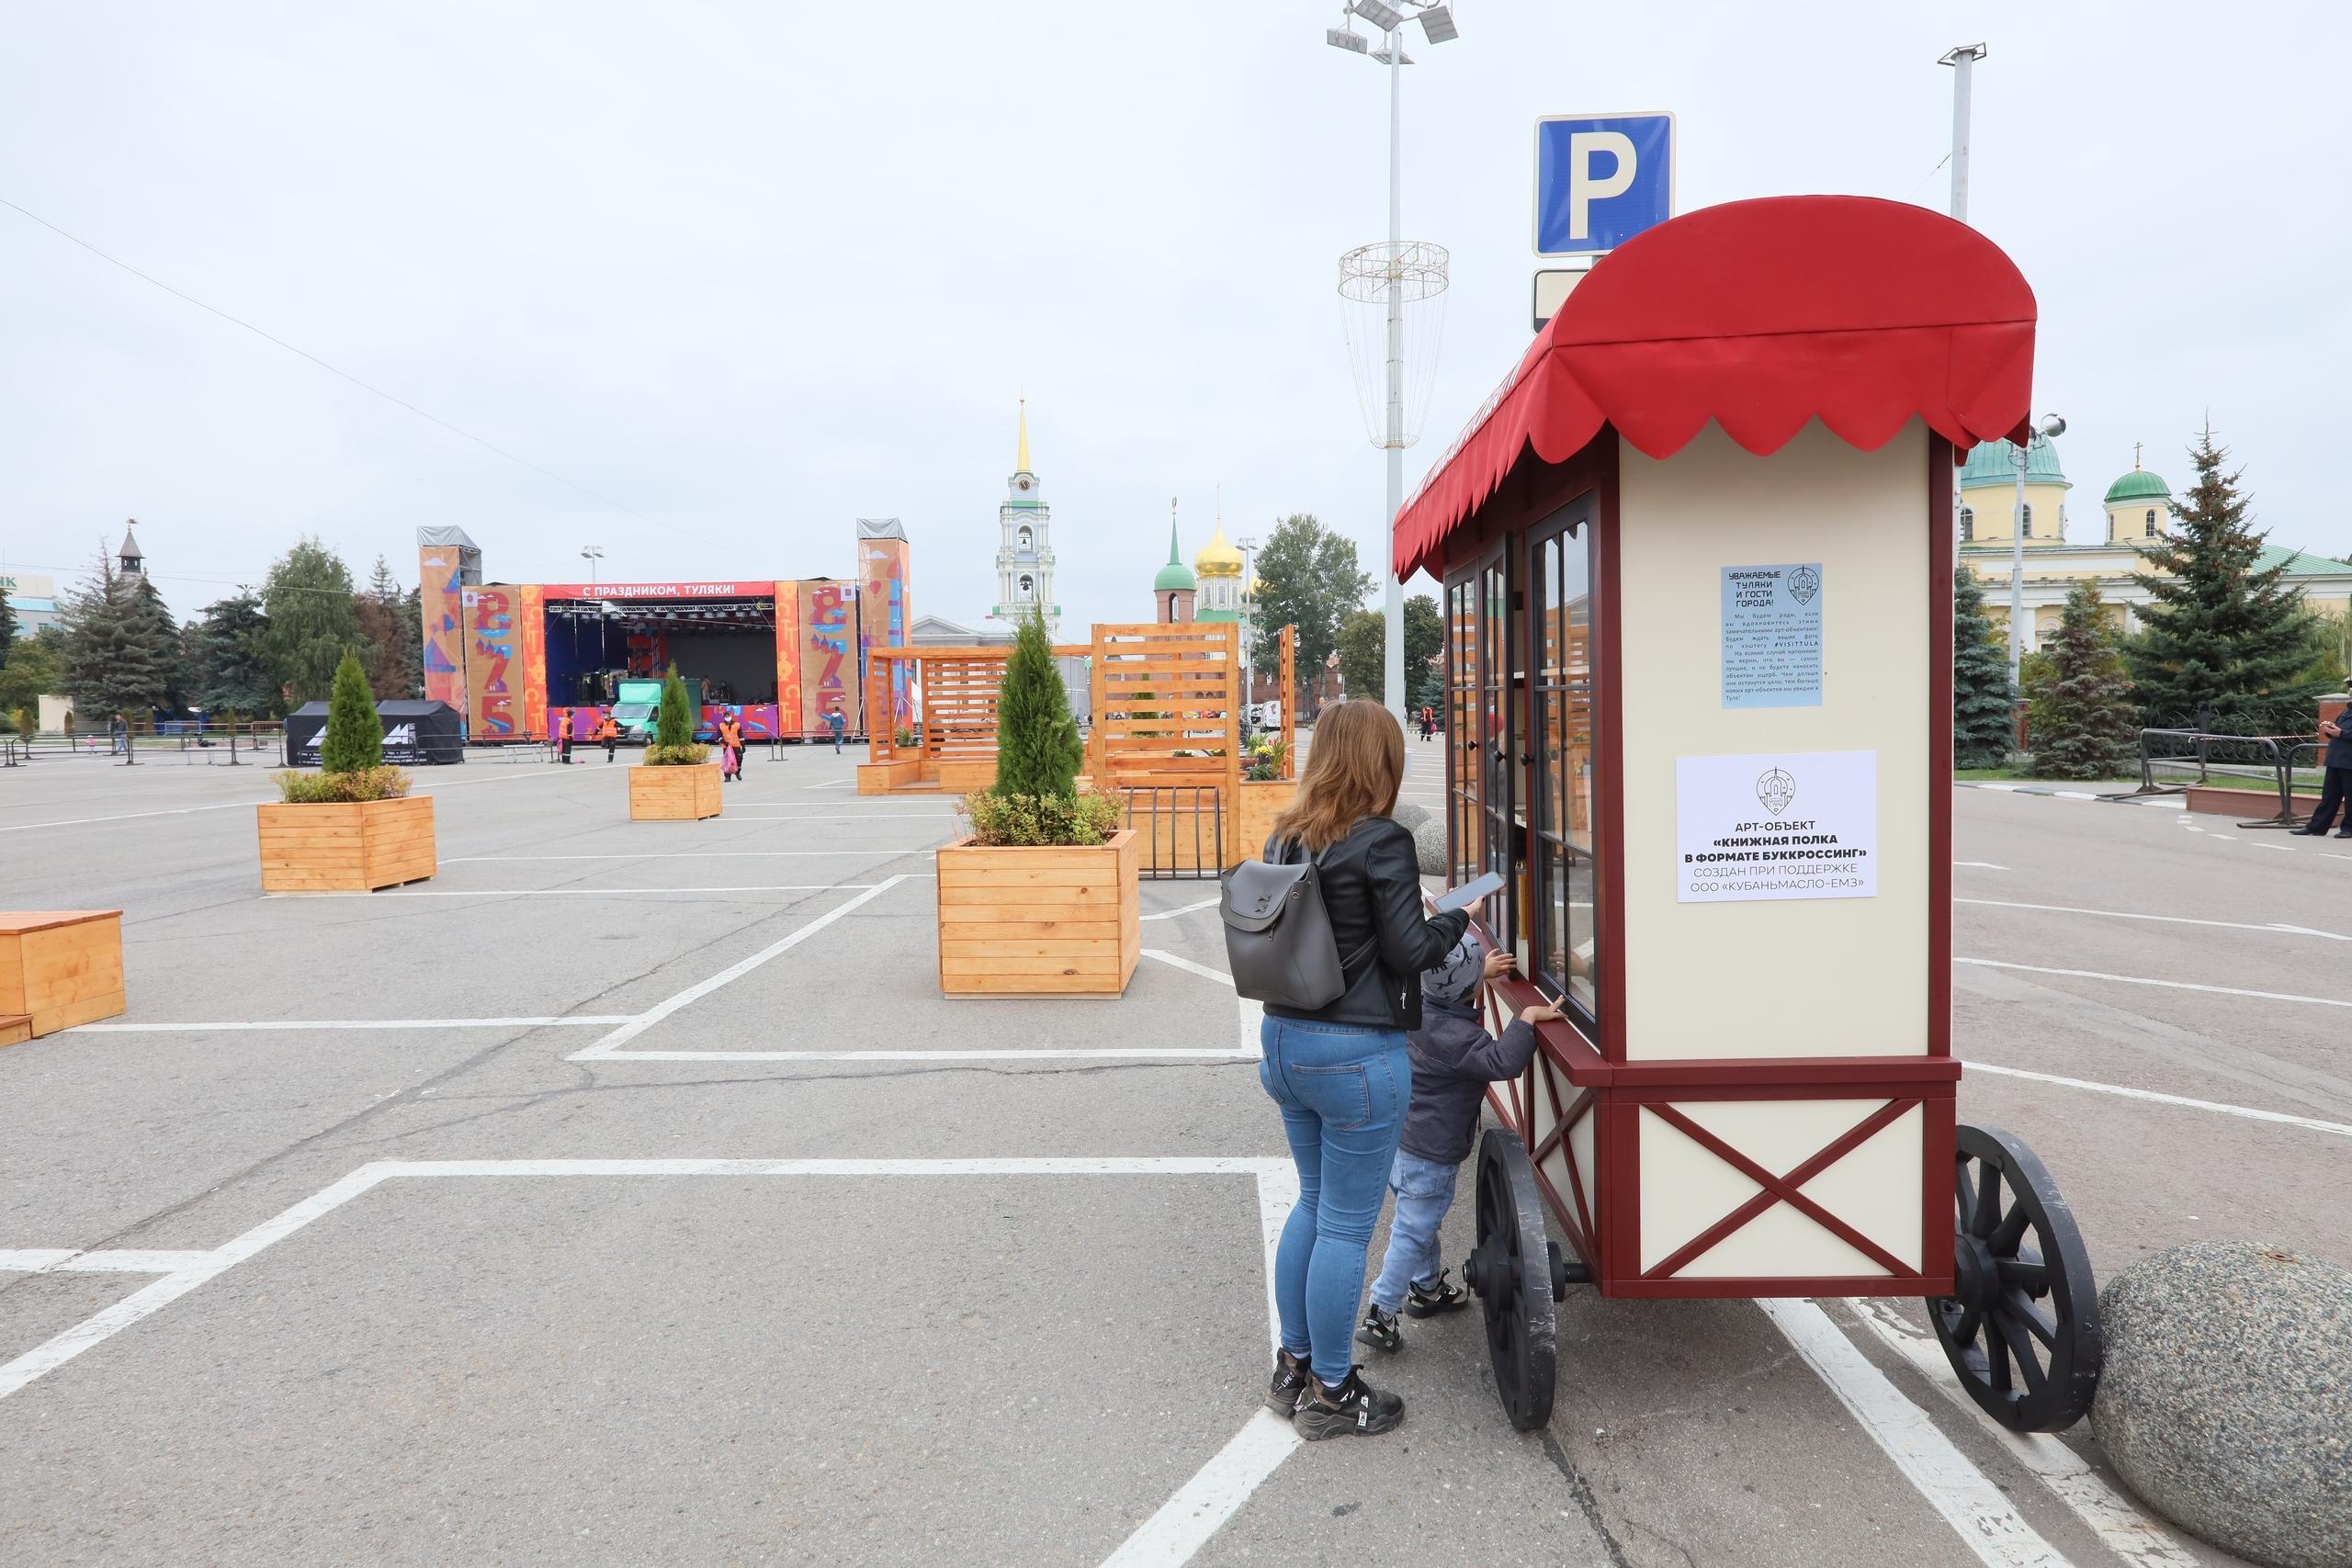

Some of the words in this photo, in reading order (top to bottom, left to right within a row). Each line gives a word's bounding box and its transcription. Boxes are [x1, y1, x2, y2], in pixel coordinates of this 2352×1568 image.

[1569, 131, 1637, 240] P
[1728, 571, 1781, 580] УВАЖАЕМЫЕ
[583, 587, 591, 597] С
[594, 585, 680, 597] ПРАЗДНИКОМ,
[684, 584, 735, 595] ТУЛЯКИ!
[1736, 599, 1773, 607] ГОРОДА!
[1735, 820, 1815, 832] АРТ-ОБЪЕКТ
[1713, 837, 1790, 848] «КНИЖНАЯ
[1792, 835, 1838, 845] ПОЛКА
[1684, 854, 1693, 863] В
[1695, 852, 1759, 863] ФОРМАТЕ
[1762, 849, 1867, 861] БУККРОССИНГ»
[1693, 867, 1747, 878] СОЗДАН
[1749, 865, 1775, 876] ПРИ
[1779, 863, 1858, 875] ПОДДЕРЖКЕ
[1690, 882, 1719, 893] ООО
[1722, 878, 1864, 891] «КУБАНЬМАСЛО-ЕМЗ»
